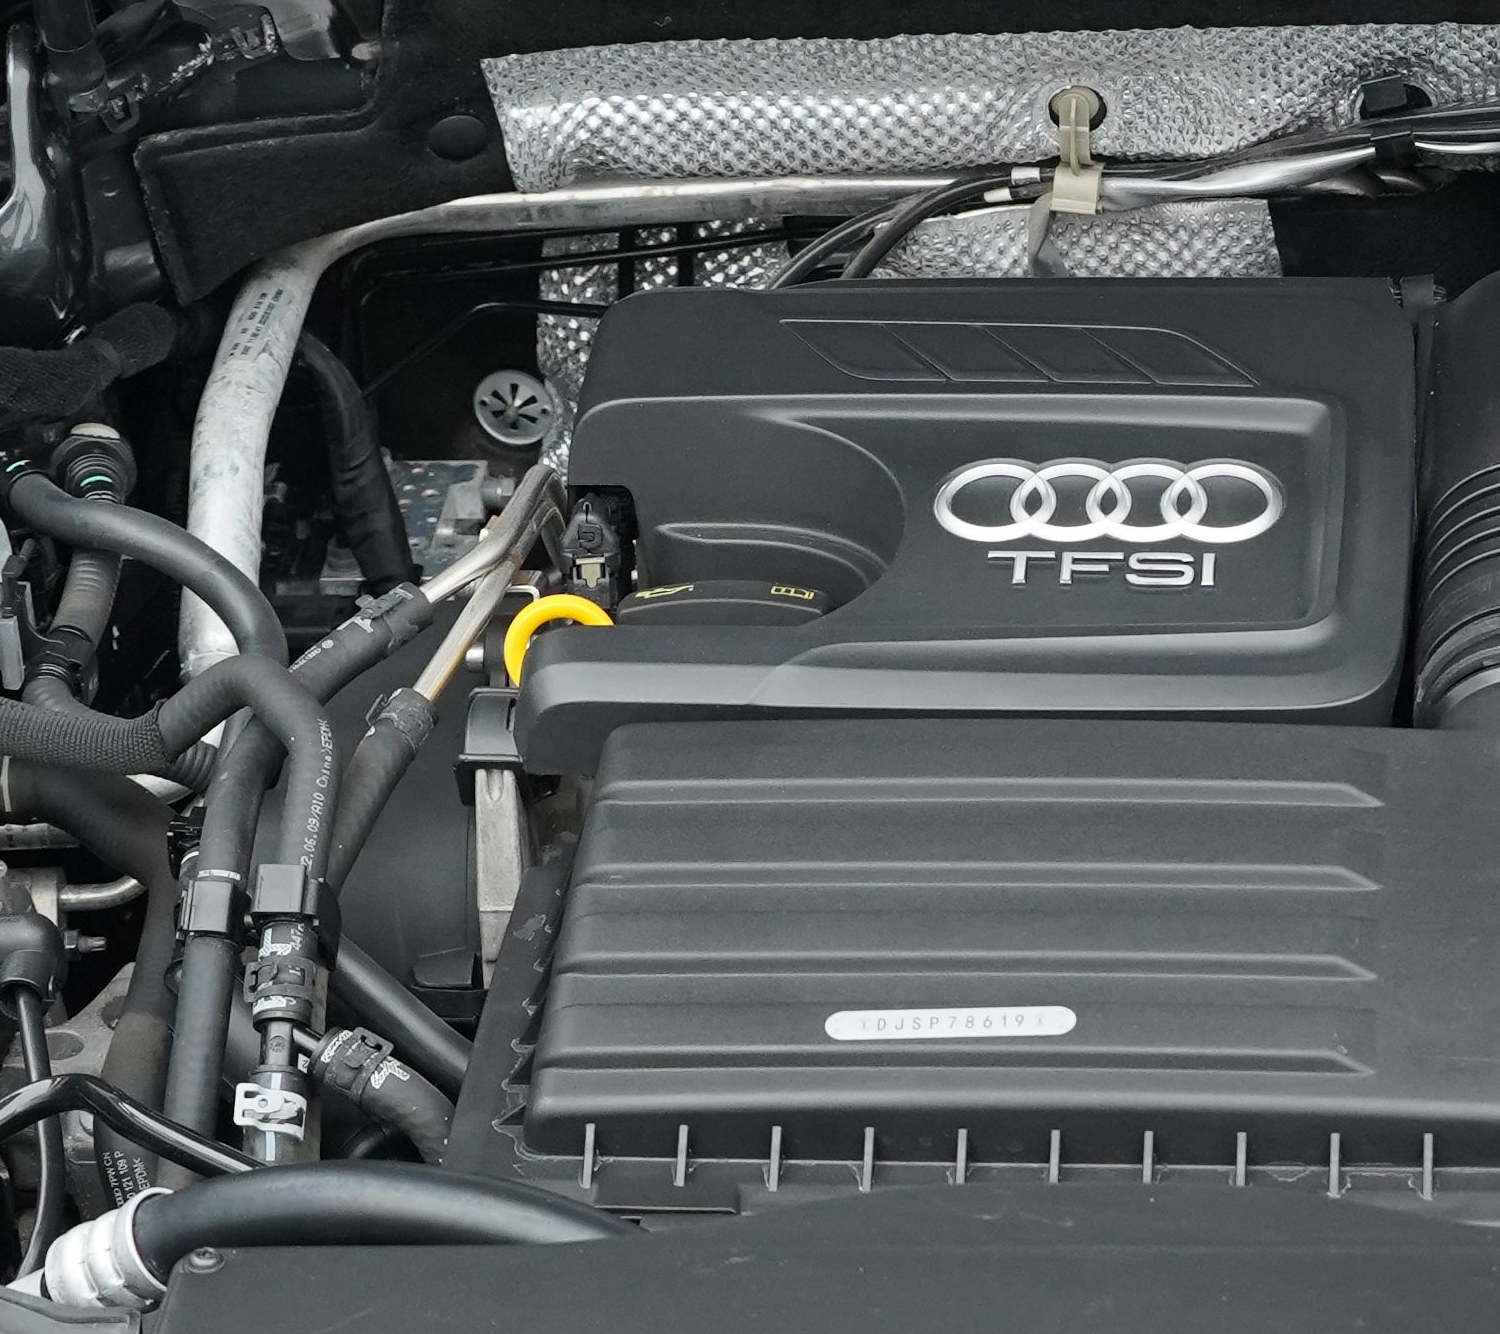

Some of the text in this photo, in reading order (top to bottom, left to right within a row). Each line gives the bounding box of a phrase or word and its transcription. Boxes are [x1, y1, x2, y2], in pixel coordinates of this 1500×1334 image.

[988, 550, 1217, 588] TFSI
[876, 1013, 1025, 1034] DJSP78619
[117, 1159, 129, 1174] 109
[121, 1177, 134, 1191] 121
